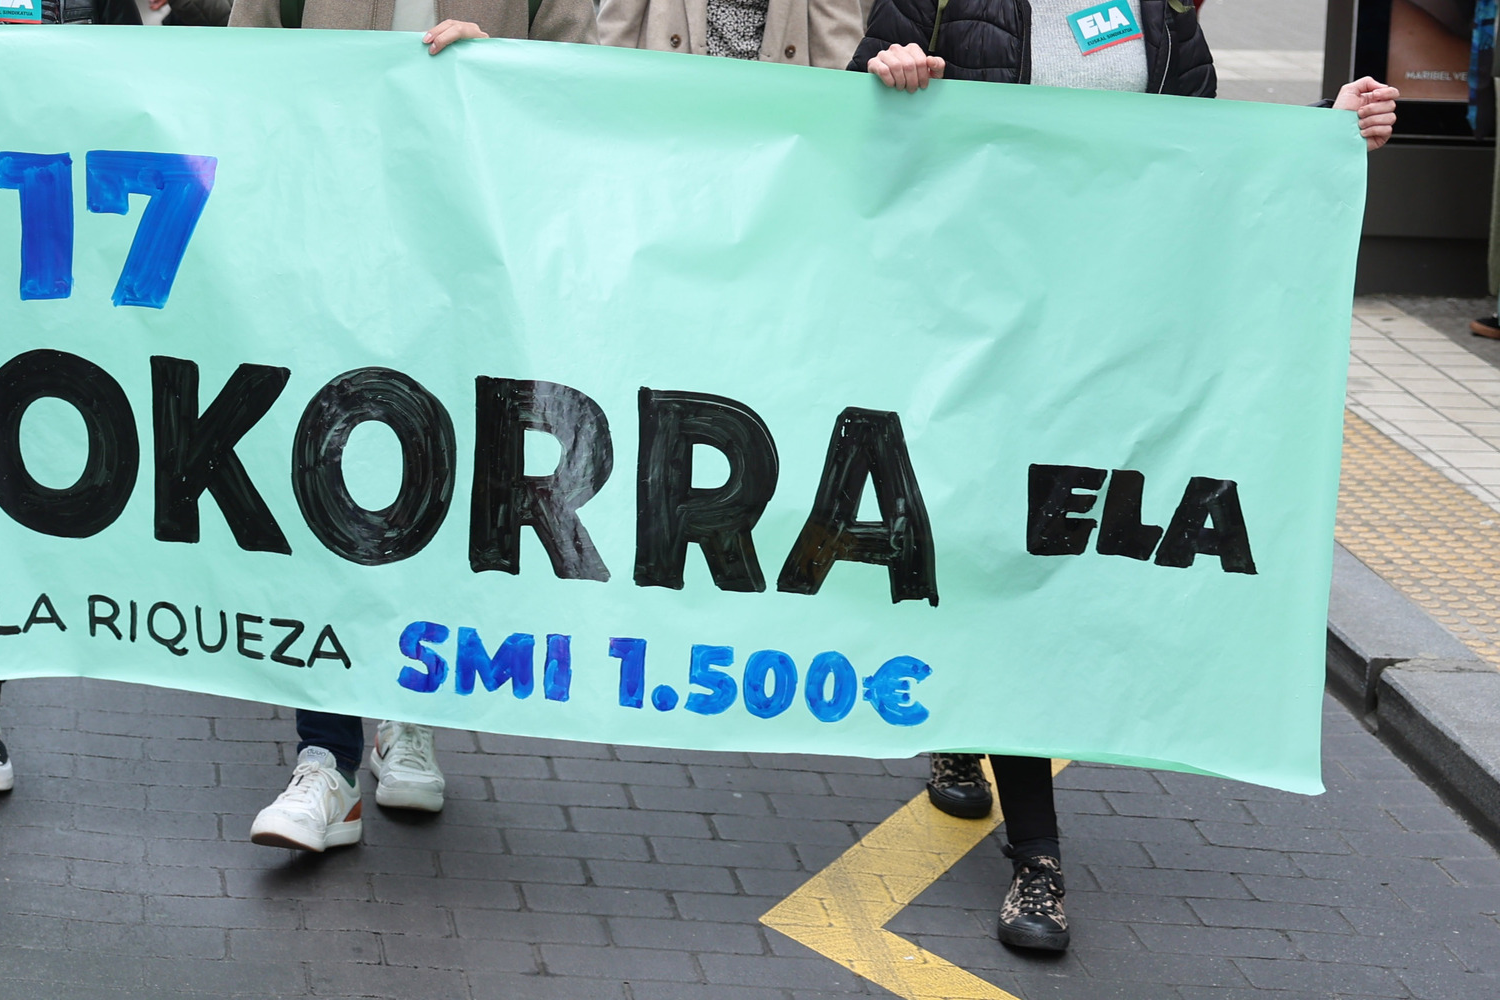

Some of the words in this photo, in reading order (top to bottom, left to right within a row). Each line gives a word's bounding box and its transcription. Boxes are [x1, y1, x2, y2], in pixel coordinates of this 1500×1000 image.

[1077, 6, 1131, 40] ELA
[1087, 37, 1107, 46] EUSKAL
[1026, 463, 1257, 576] ELA
[86, 593, 353, 670] RIQUEZA
[396, 620, 574, 704] SMI
[608, 636, 933, 728] 1.500€
